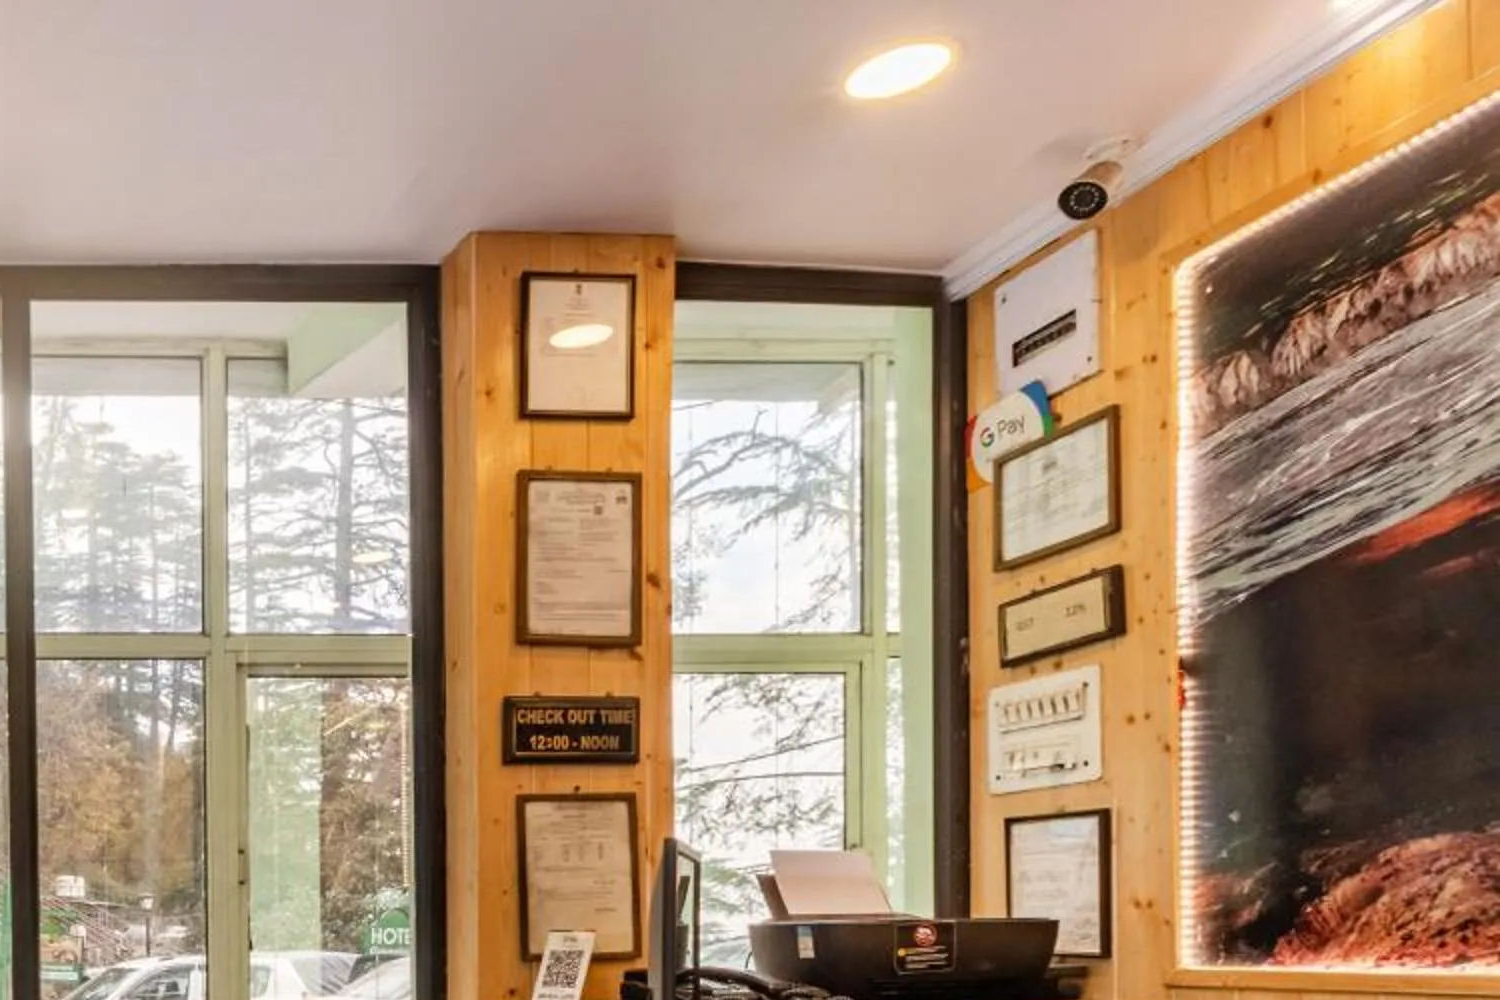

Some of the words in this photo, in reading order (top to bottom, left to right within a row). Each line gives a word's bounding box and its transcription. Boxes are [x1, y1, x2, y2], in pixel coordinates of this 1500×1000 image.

[980, 427, 994, 448] G
[996, 416, 1025, 438] Pay
[517, 709, 564, 725] CHECK
[567, 709, 596, 725] OUT
[600, 709, 633, 725] TIME
[529, 735, 569, 751] 12:00
[581, 735, 619, 751] NOON
